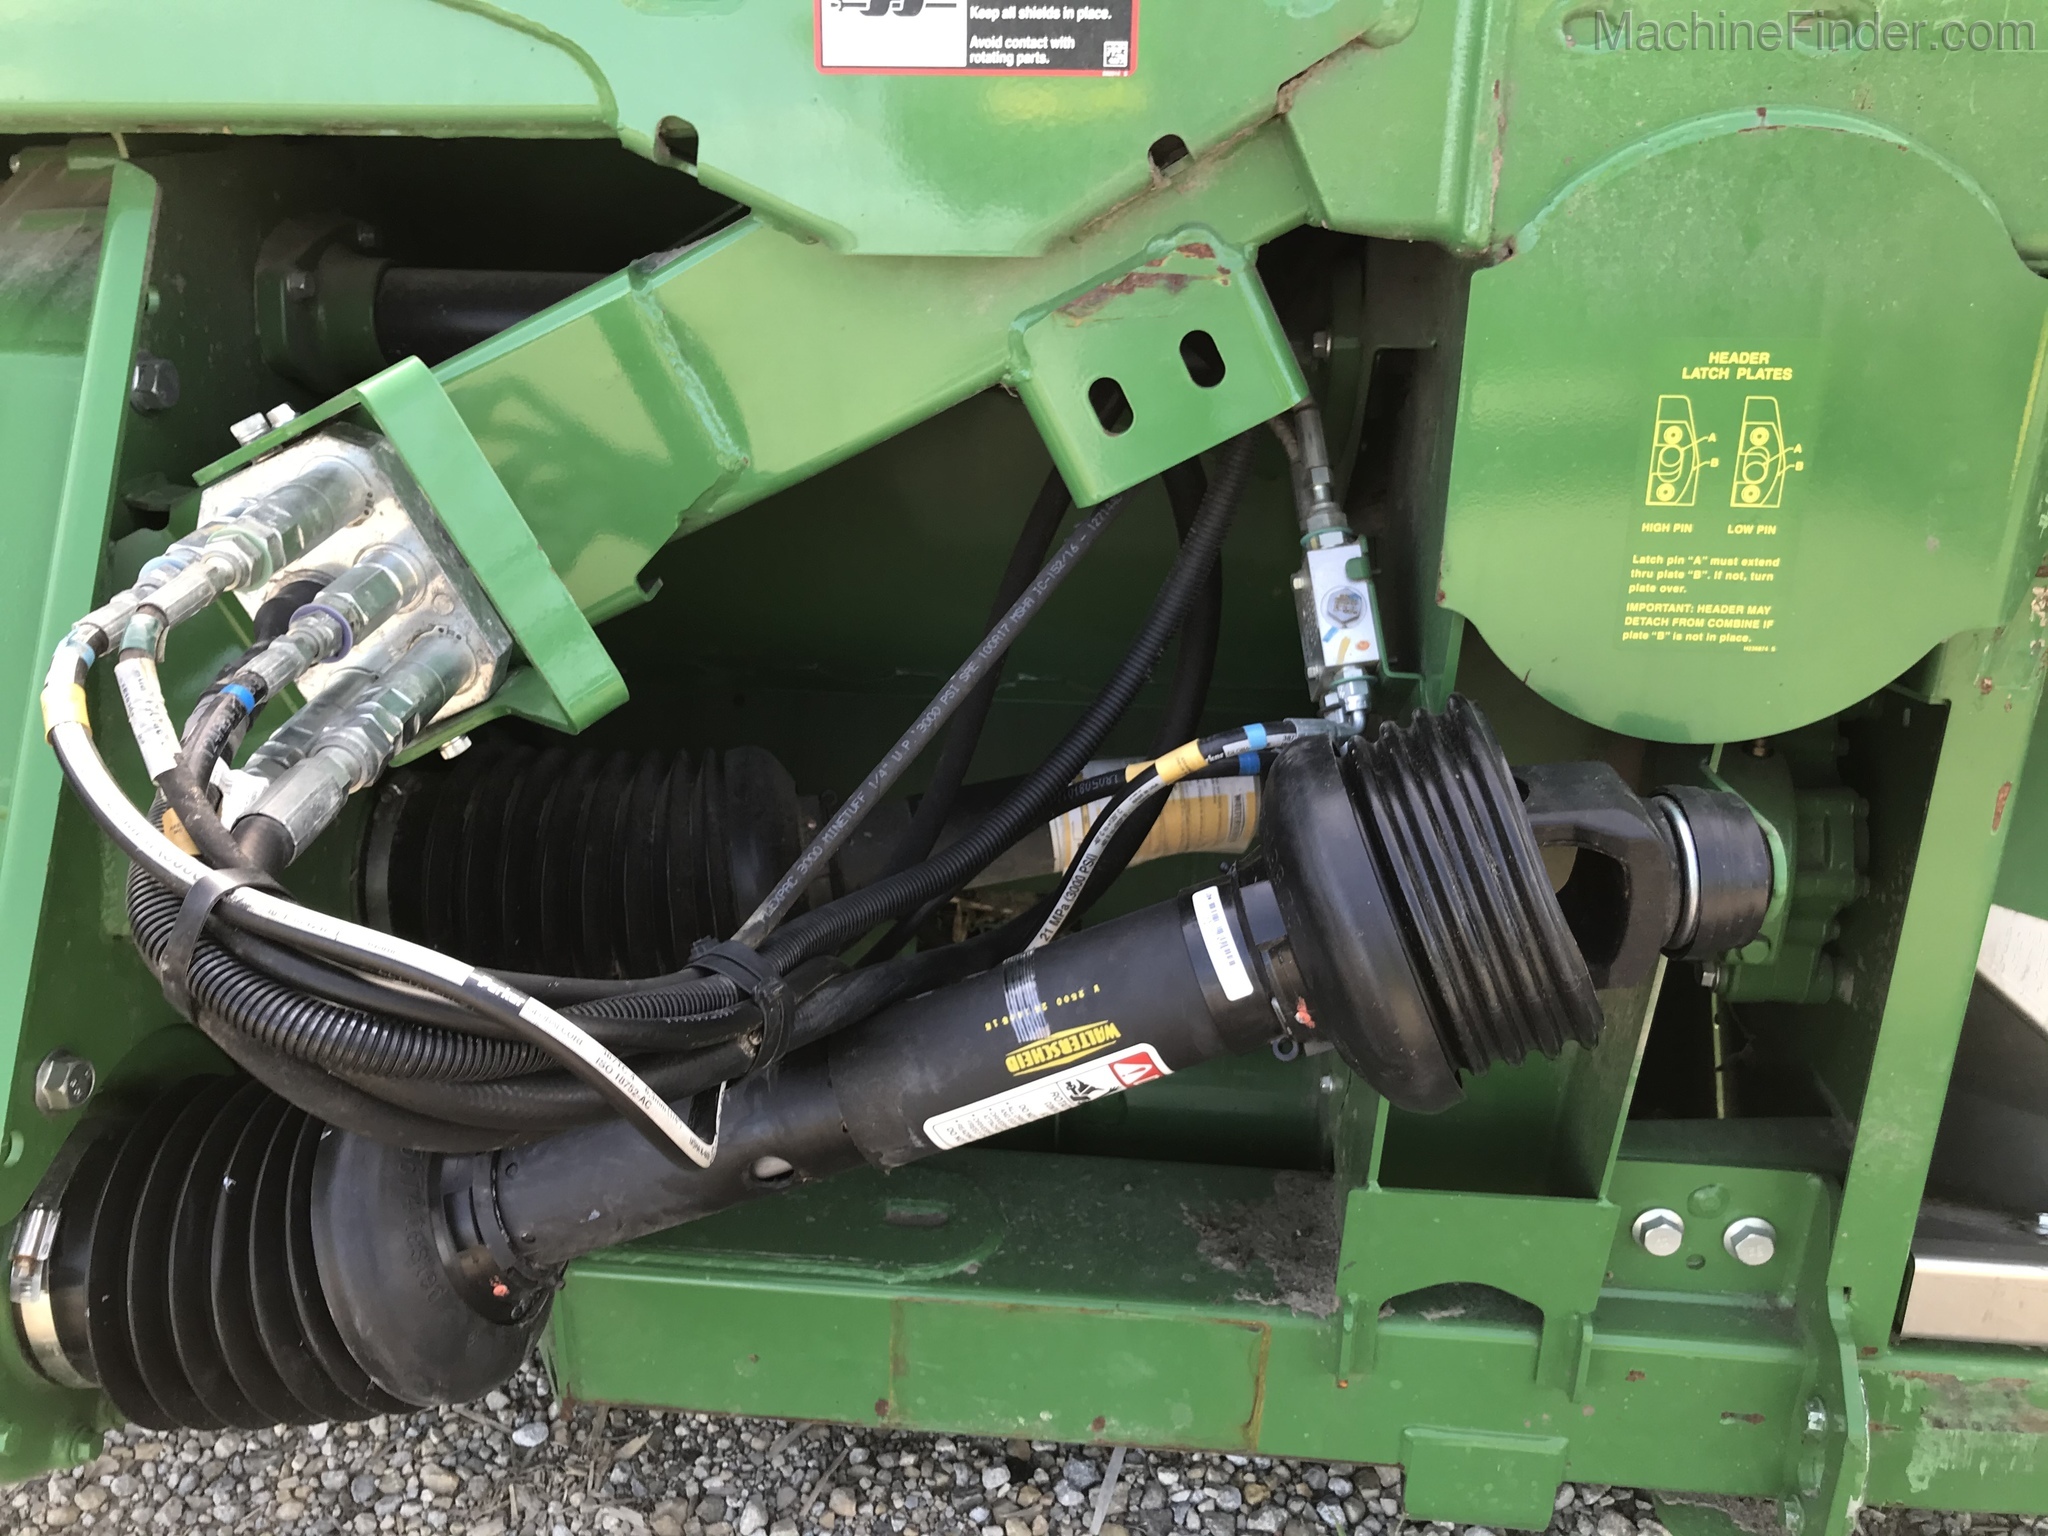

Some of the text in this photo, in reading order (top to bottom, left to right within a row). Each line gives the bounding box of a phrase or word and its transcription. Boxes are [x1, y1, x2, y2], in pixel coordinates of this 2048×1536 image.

[969, 6, 1112, 22] Keep all shields in place.
[969, 35, 1075, 49] Avoid contact with
[969, 51, 1050, 66] rotating parts.
[1709, 352, 1769, 364] HEADER
[1682, 367, 1792, 380] LATCH PLATES
[1708, 433, 1717, 443] A
[1793, 444, 1802, 454] A
[1710, 458, 1719, 467] B
[1795, 461, 1803, 471] B
[1641, 523, 1692, 533] HIGH PIN
[1727, 525, 1776, 535] LOW PIN
[1633, 555, 1663, 564] Latch
[1667, 555, 1684, 566] pin
[1710, 557, 1738, 566] must
[1741, 557, 1780, 567] extend
[1631, 569, 1653, 578] thru
[1657, 570, 1685, 580] plate
[1714, 571, 1723, 579] If
[1725, 571, 1746, 581] not,
[1751, 572, 1774, 581] turn
[1629, 584, 1687, 594] plate over.
[1626, 603, 1771, 615] IMPORTANT: HEADER MAY
[1625, 617, 1774, 629] DETACH FROM COMBINE IF
[1622, 631, 1649, 641] plate
[1686, 633, 1703, 641] not
[1706, 633, 1716, 642] in
[1719, 634, 1751, 643] place.
[795, 843, 824, 876] 3000
[820, 790, 868, 845] MINETUFF
[938, 683, 960, 705] PSI
[957, 660, 979, 683] SAE
[1039, 852, 1097, 942] 21 MPa (3000 PSI)
[477, 974, 527, 1008] Parker
[1005, 1023, 1121, 1072] WALTERSCHEID
